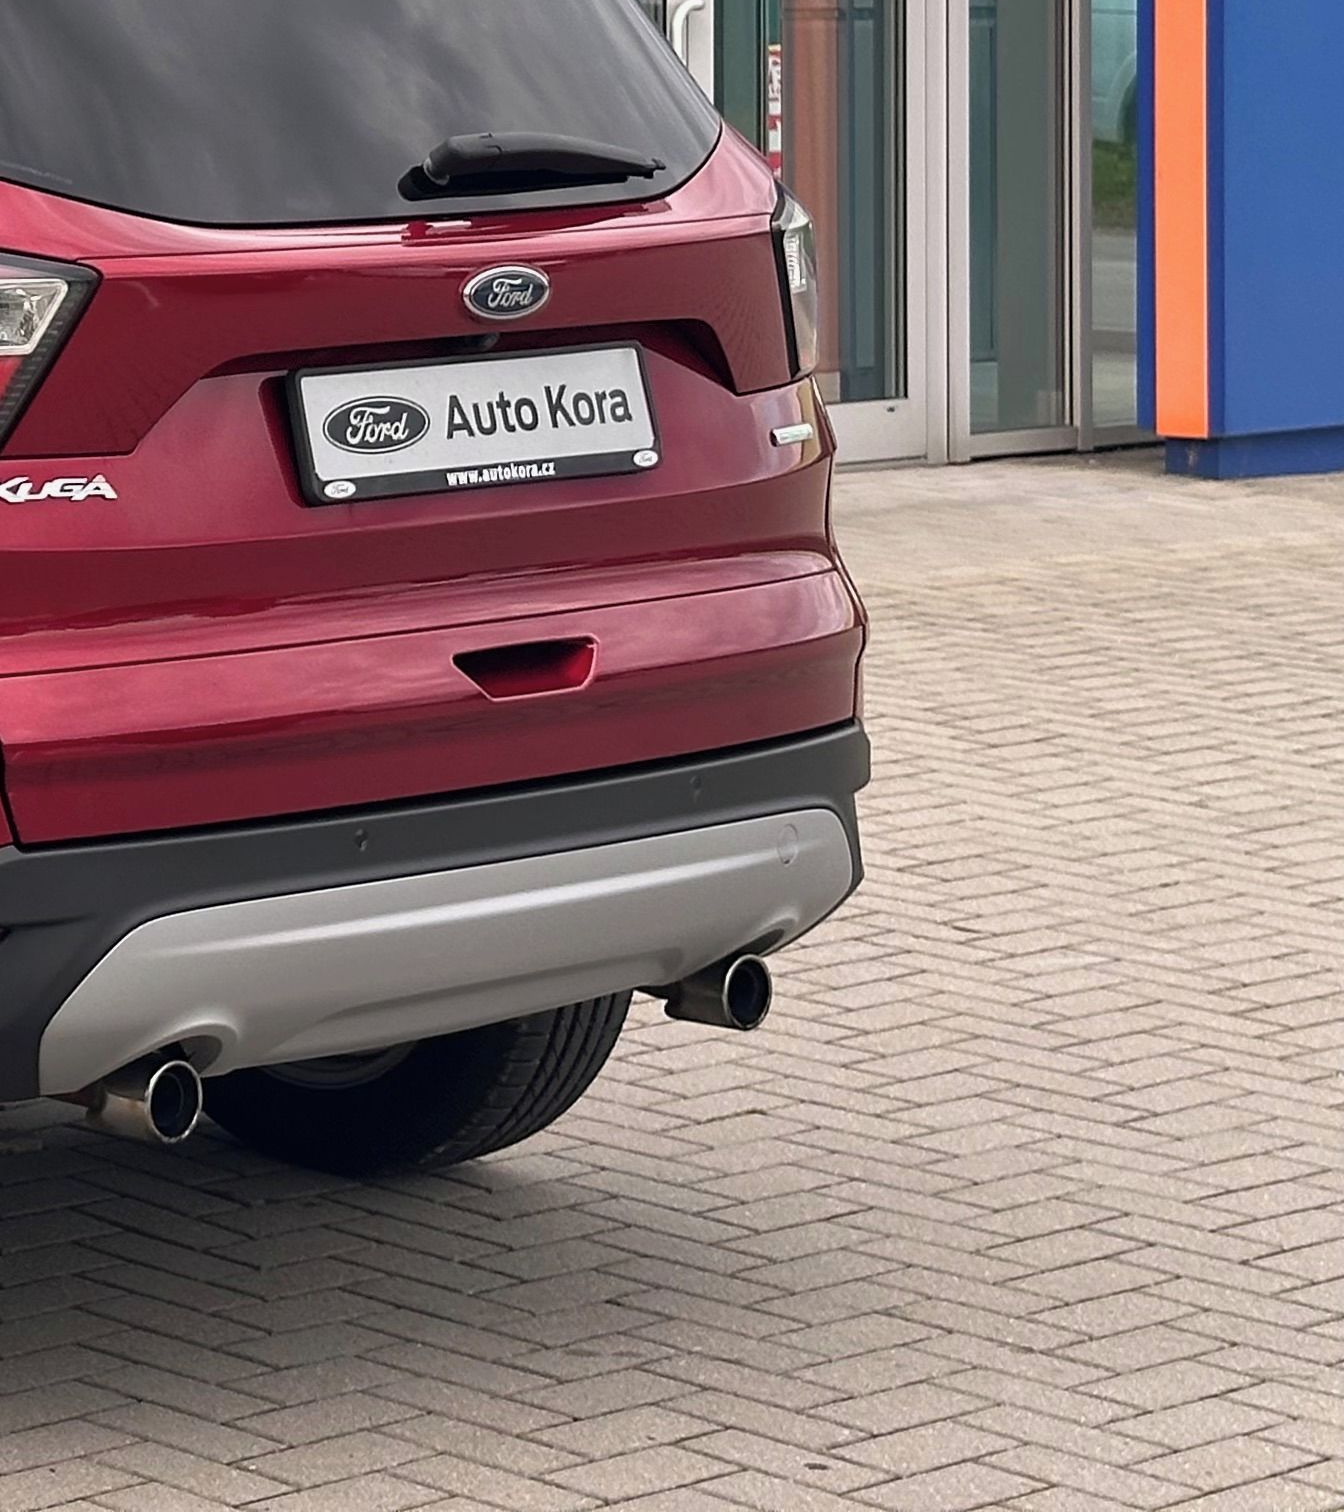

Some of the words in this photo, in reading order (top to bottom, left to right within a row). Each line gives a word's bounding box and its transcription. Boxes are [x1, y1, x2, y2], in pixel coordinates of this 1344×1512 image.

[487, 278, 534, 308] Ford
[346, 405, 410, 445] Ford
[446, 390, 540, 440] Auto
[544, 384, 633, 429] Kora
[446, 461, 556, 487] www.autokora.cz
